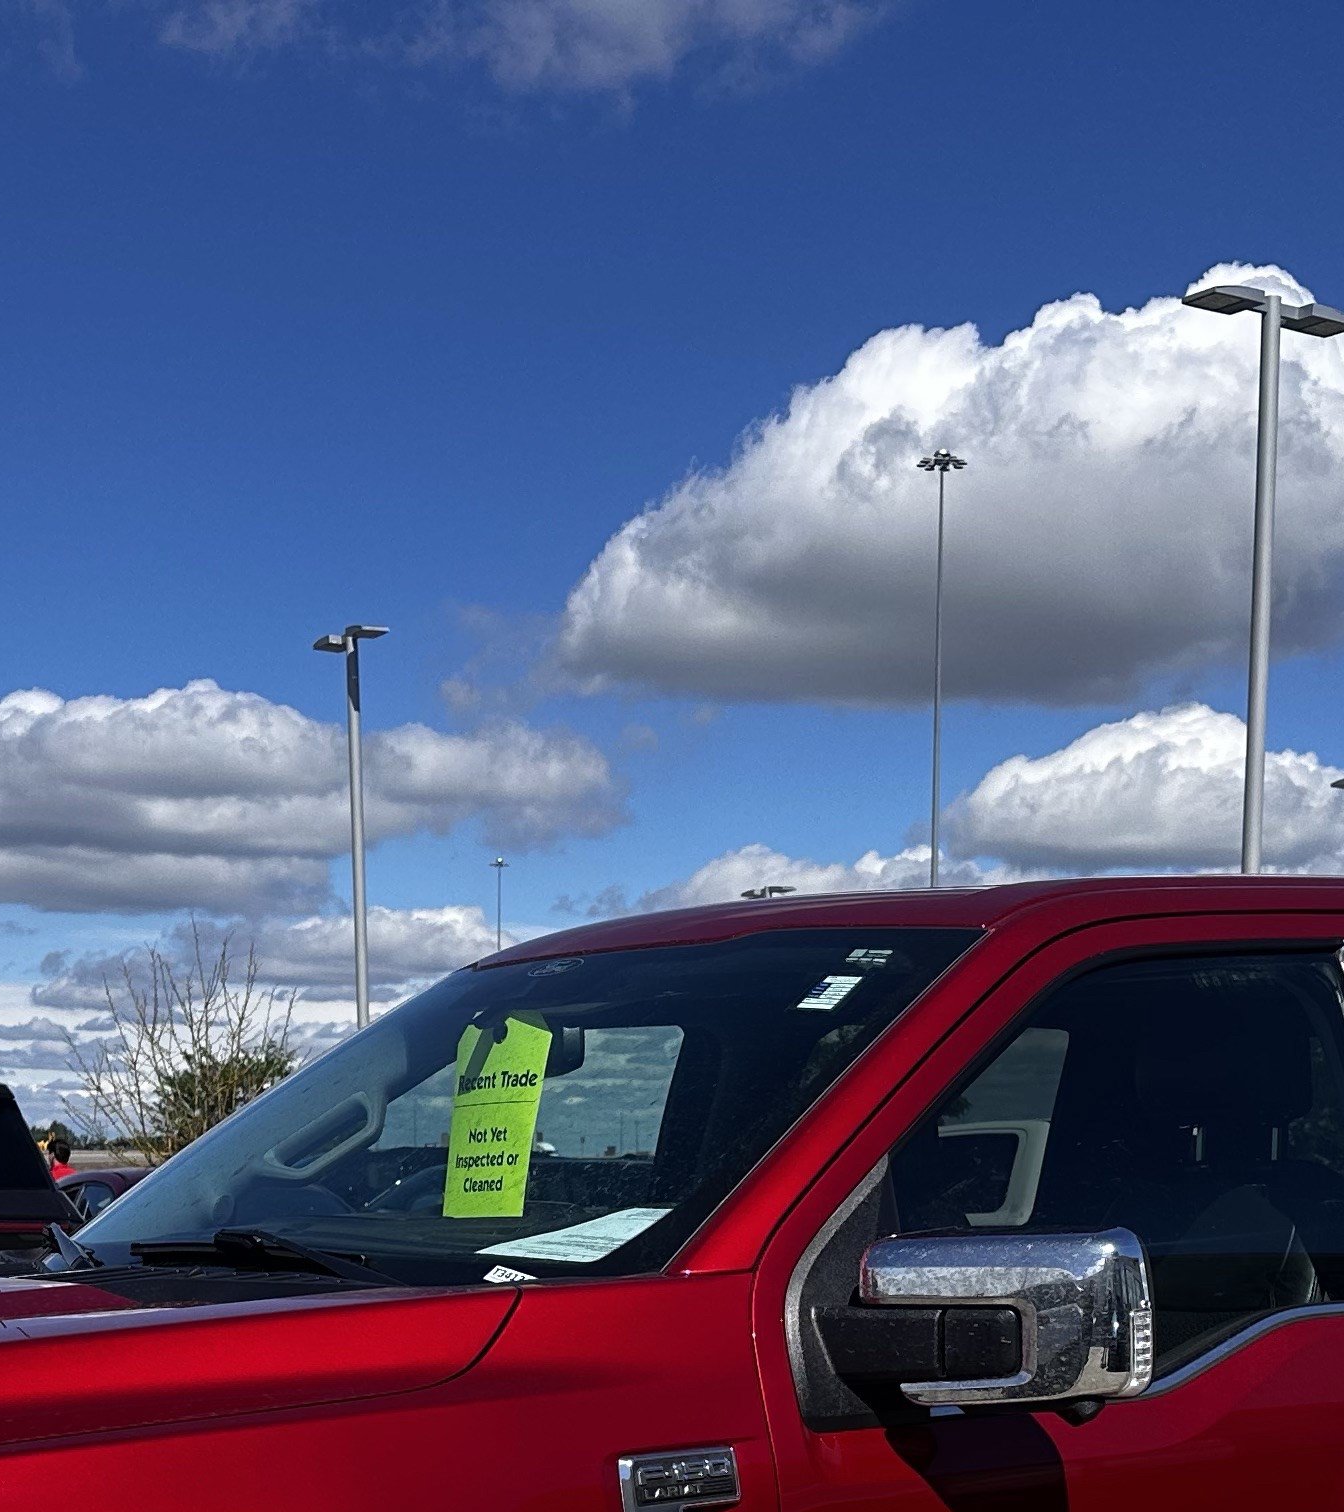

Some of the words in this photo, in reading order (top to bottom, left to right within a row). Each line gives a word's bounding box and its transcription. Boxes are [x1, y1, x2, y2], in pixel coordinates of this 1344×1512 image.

[458, 1069, 496, 1093] Recent
[500, 1069, 539, 1089] Trade
[468, 1128, 488, 1144] Not
[490, 1126, 508, 1142] Yet
[455, 1151, 504, 1171] Inspected
[507, 1153, 519, 1167] or
[463, 1176, 503, 1193] Cleaned
[644, 1483, 704, 1500] LARIAT
